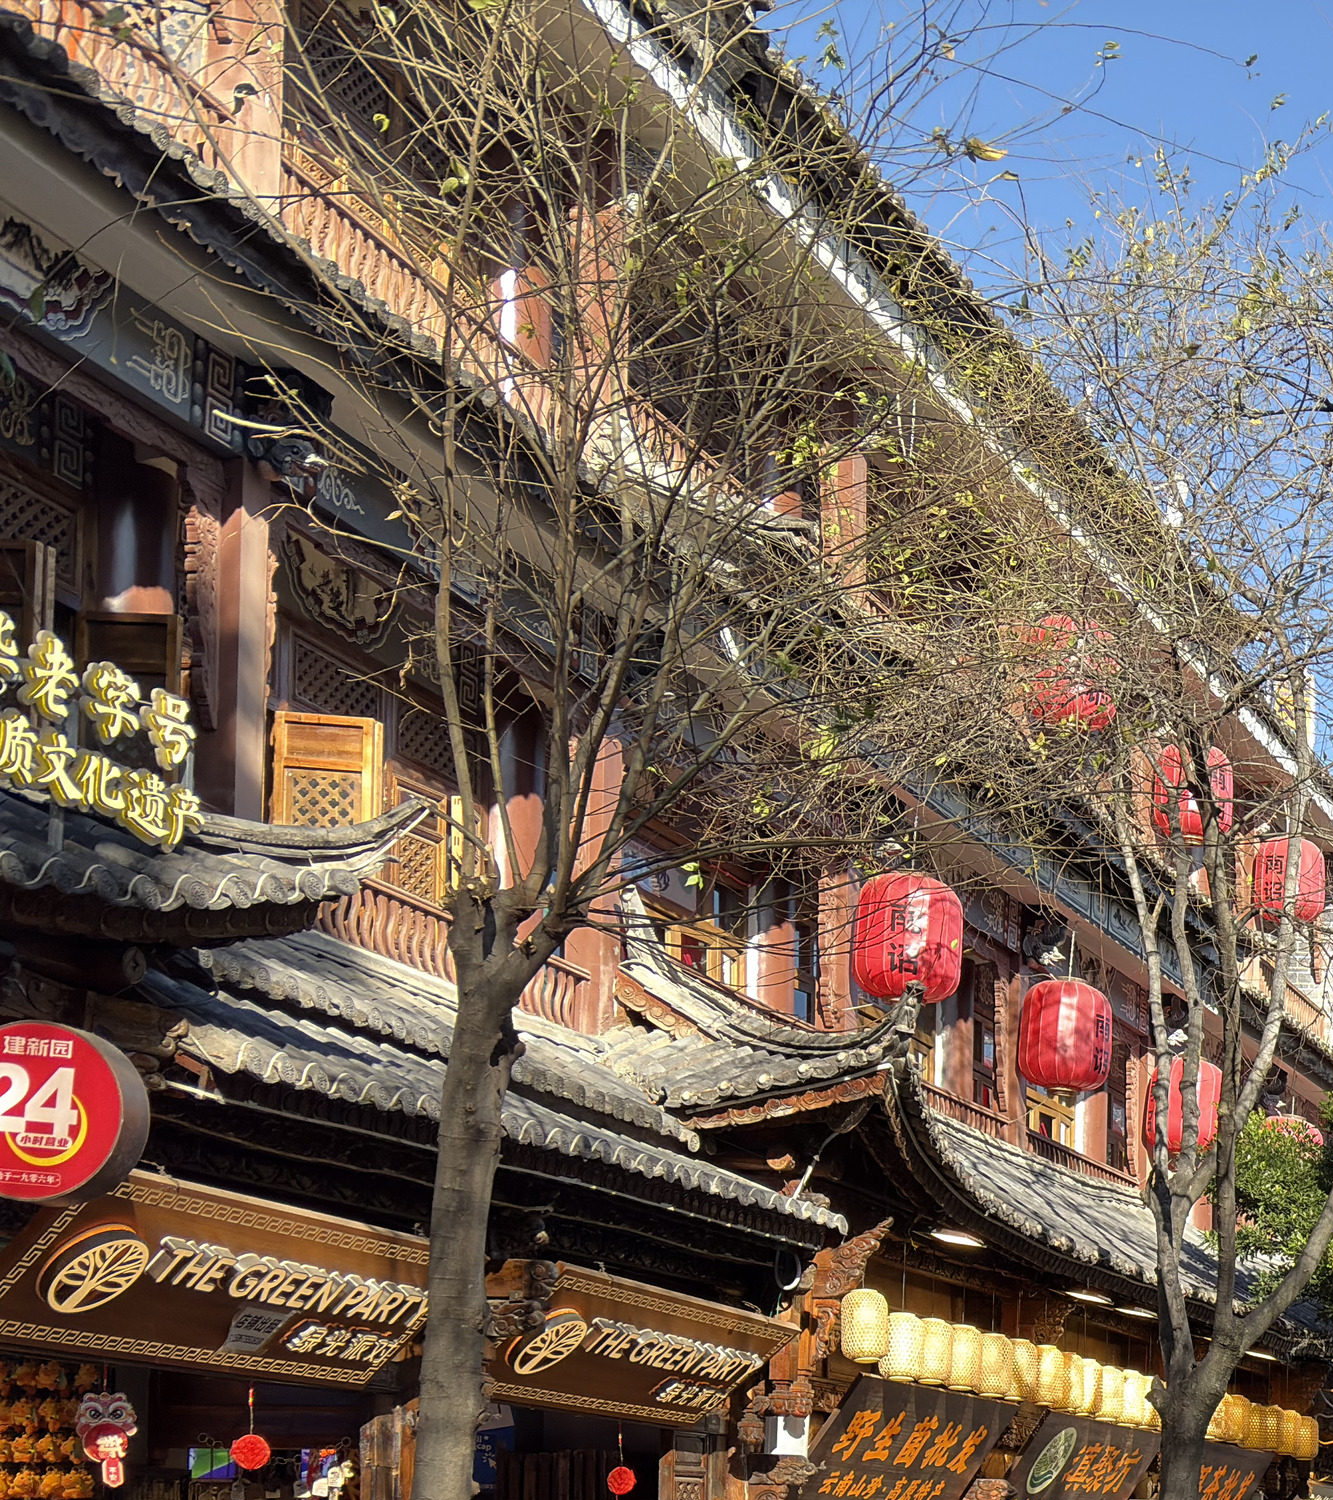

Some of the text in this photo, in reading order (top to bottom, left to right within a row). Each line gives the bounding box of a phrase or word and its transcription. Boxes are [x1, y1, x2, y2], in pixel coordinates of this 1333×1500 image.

[0, 712, 205, 846] 质文化遗产
[887, 903, 922, 976] 南诏
[3, 1035, 74, 1059] 建新园
[0, 1062, 78, 1138] 24
[19, 1136, 69, 1148] 小时营业
[155, 1248, 428, 1328] THE GREEN PARTY
[287, 1326, 401, 1363] 绿光派对
[585, 1327, 760, 1384] THE GREEN PARTY
[832, 1409, 988, 1474] 野生菌批发
